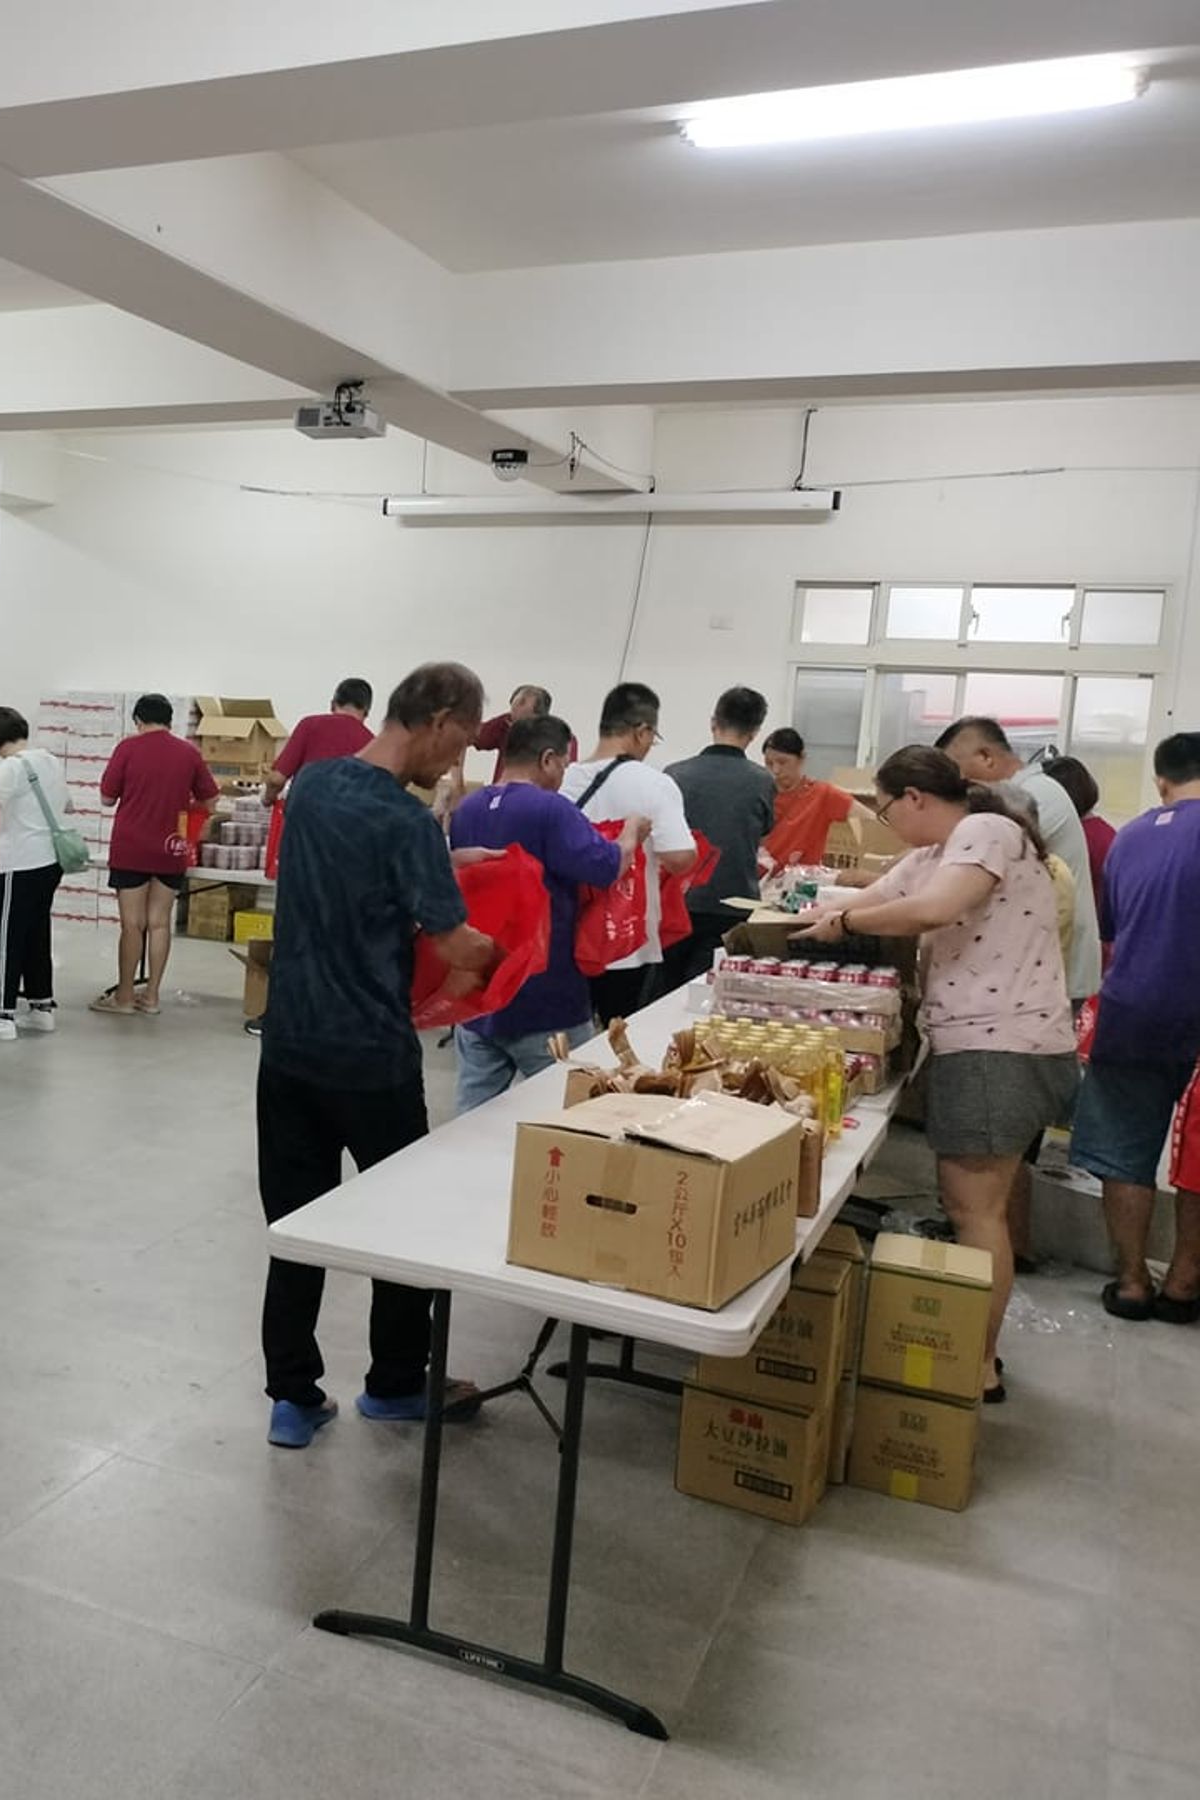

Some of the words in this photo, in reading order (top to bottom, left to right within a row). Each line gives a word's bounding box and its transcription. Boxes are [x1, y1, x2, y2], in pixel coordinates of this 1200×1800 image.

[703, 1414, 788, 1459] 大豆沙拉油
